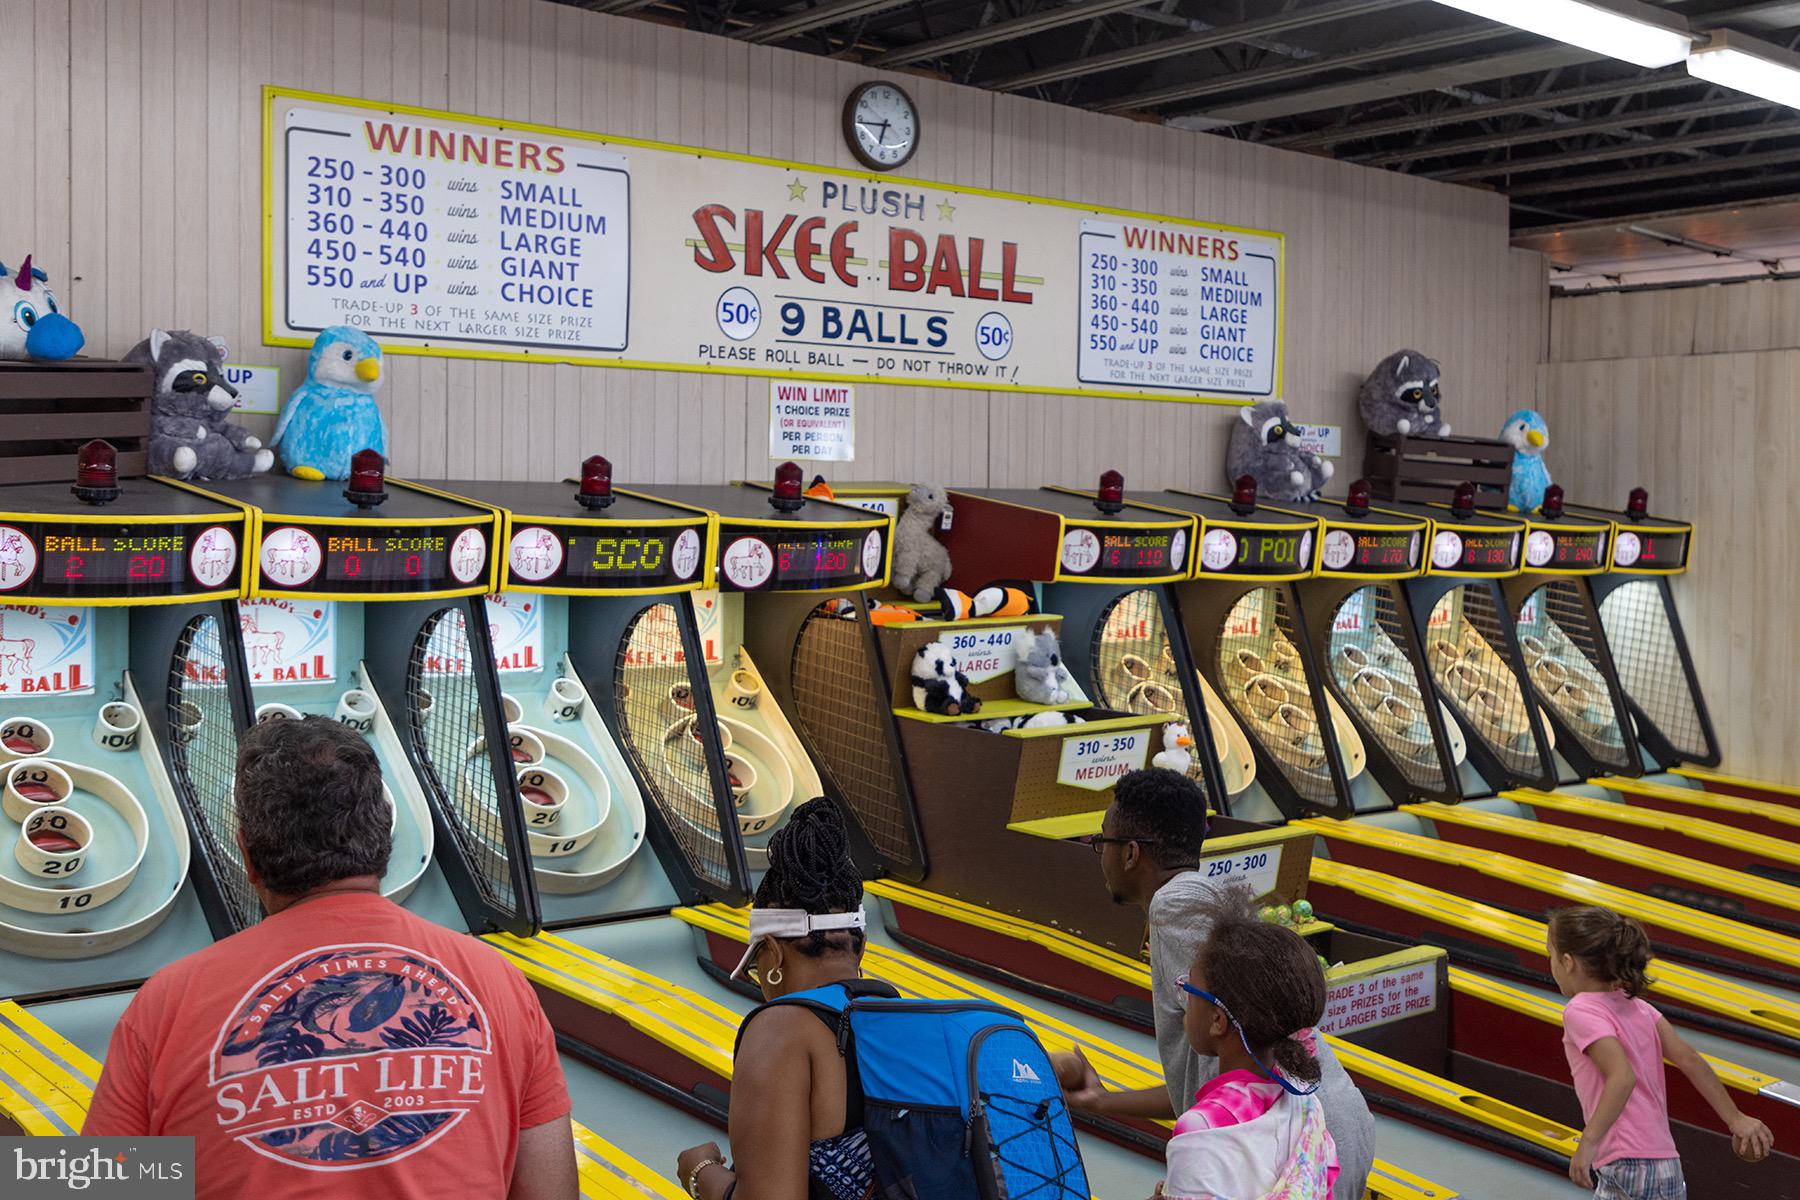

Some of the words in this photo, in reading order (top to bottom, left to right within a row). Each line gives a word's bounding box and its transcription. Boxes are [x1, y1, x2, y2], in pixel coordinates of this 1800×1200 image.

[904, 111, 910, 120] 2
[905, 127, 911, 136] 3
[365, 121, 565, 174] WINNERS
[868, 145, 874, 153] 7
[892, 150, 898, 158] 5
[447, 177, 480, 193] wins
[501, 180, 582, 208] SMALL
[822, 181, 926, 220] PLUSH
[447, 204, 479, 220] wins
[500, 206, 607, 235] MEDIUM
[447, 230, 479, 246] wins
[500, 232, 582, 257] LARGE
[691, 203, 859, 288] SKEE
[888, 226, 1033, 304] BALL
[1124, 226, 1240, 262] WINNERS
[447, 256, 479, 272] wins
[501, 257, 580, 282] GIANT
[1201, 267, 1248, 286] SMALL
[307, 265, 353, 288] 550
[360, 274, 387, 289] and
[394, 273, 428, 294] UP
[447, 281, 479, 297] wins
[501, 282, 594, 308] CHOICE
[1200, 286, 1262, 307] MEDIUM
[332, 298, 404, 316] TRADE-UP
[410, 304, 418, 316] 3
[425, 305, 442, 318] OF
[449, 307, 475, 321] THE
[484, 309, 520, 324] SAME
[527, 312, 552, 325] SIZE
[560, 314, 593, 328] PRIZE
[721, 302, 758, 325] 50¢
[1200, 305, 1248, 324] LARGE
[344, 313, 371, 327] FOR
[378, 316, 406, 330] THE
[414, 318, 450, 332] NEXT
[458, 321, 508, 336] LARGER
[515, 325, 540, 338] SIZE
[547, 327, 581, 342] PRIZE
[780, 302, 806, 336] 9
[822, 306, 948, 348] BALLS
[1200, 324, 1246, 344] GIANT
[980, 326, 1010, 346] 50¢
[1090, 334, 1117, 351] 550
[1138, 339, 1159, 355] UP
[1200, 344, 1254, 363] CHOICE
[699, 344, 756, 362] PLEASE
[765, 349, 800, 364] ROLL
[807, 351, 845, 367] BALL
[877, 356, 896, 370] DO
[903, 358, 930, 373] NOT
[938, 361, 989, 377] THROW
[1104, 358, 1144, 369] TRADE-UP
[1147, 361, 1153, 370] 3
[1156, 362, 1166, 371] OF
[1170, 362, 1185, 373] THE
[1190, 364, 1210, 375] SAME
[1215, 366, 1230, 376] SIZE
[1234, 368, 1254, 378] PRIZE
[228, 368, 252, 384] UP
[1110, 370, 1126, 379] FOR
[1130, 372, 1146, 380] THE
[1150, 372, 1170, 382] NEXT
[1174, 374, 1202, 385] LARGER
[1206, 376, 1222, 386] SIZE
[1226, 377, 1246, 388] PRIZE
[778, 386, 807, 401] WIN
[814, 387, 848, 403] LIMIT
[776, 405, 781, 414] 1
[784, 405, 820, 416] CHOICE
[824, 407, 850, 417] PRIZE
[782, 432, 800, 440] PER
[1318, 428, 1330, 438] UP
[792, 445, 810, 454] PER
[45, 536, 106, 552] BALL
[328, 537, 379, 552] BALL
[385, 537, 444, 552] SCORE
[1134, 536, 1168, 547] SCORE
[592, 538, 664, 570] SCO
[780, 553, 790, 571] 6
[815, 552, 847, 571] 120
[66, 556, 84, 578] 2
[129, 555, 165, 578] 20
[345, 555, 360, 576] 0
[406, 555, 420, 576] 0
[273, 655, 330, 680] BALL
[957, 658, 1000, 673] LARGE
[22, 664, 88, 692] BALL
[1074, 763, 1130, 781] MEDIUM
[532, 812, 560, 825] 20
[742, 820, 766, 832] 10
[550, 840, 576, 853] 10
[42, 858, 80, 874] 20
[59, 894, 92, 910] 10
[250, 974, 308, 1024] SALTY
[320, 959, 388, 973] TIMES
[401, 964, 458, 1006] AHEAD
[1328, 985, 1354, 1002] RADE
[1358, 984, 1365, 994] 3
[1368, 980, 1378, 992] of
[1382, 976, 1397, 988] the
[1400, 970, 1424, 984] same
[1327, 1004, 1346, 1018] size
[1350, 994, 1384, 1011] PRIZES
[1388, 990, 1401, 1002] for
[1404, 986, 1418, 998] the
[1338, 1011, 1377, 1030] LARGER
[1381, 1003, 1402, 1018] SIZE
[1406, 996, 1431, 1010] PRIZE
[216, 1062, 360, 1126] SALT
[375, 1054, 485, 1095] LIFE
[293, 1104, 337, 1120] ESTD
[384, 1095, 425, 1108] 2003
